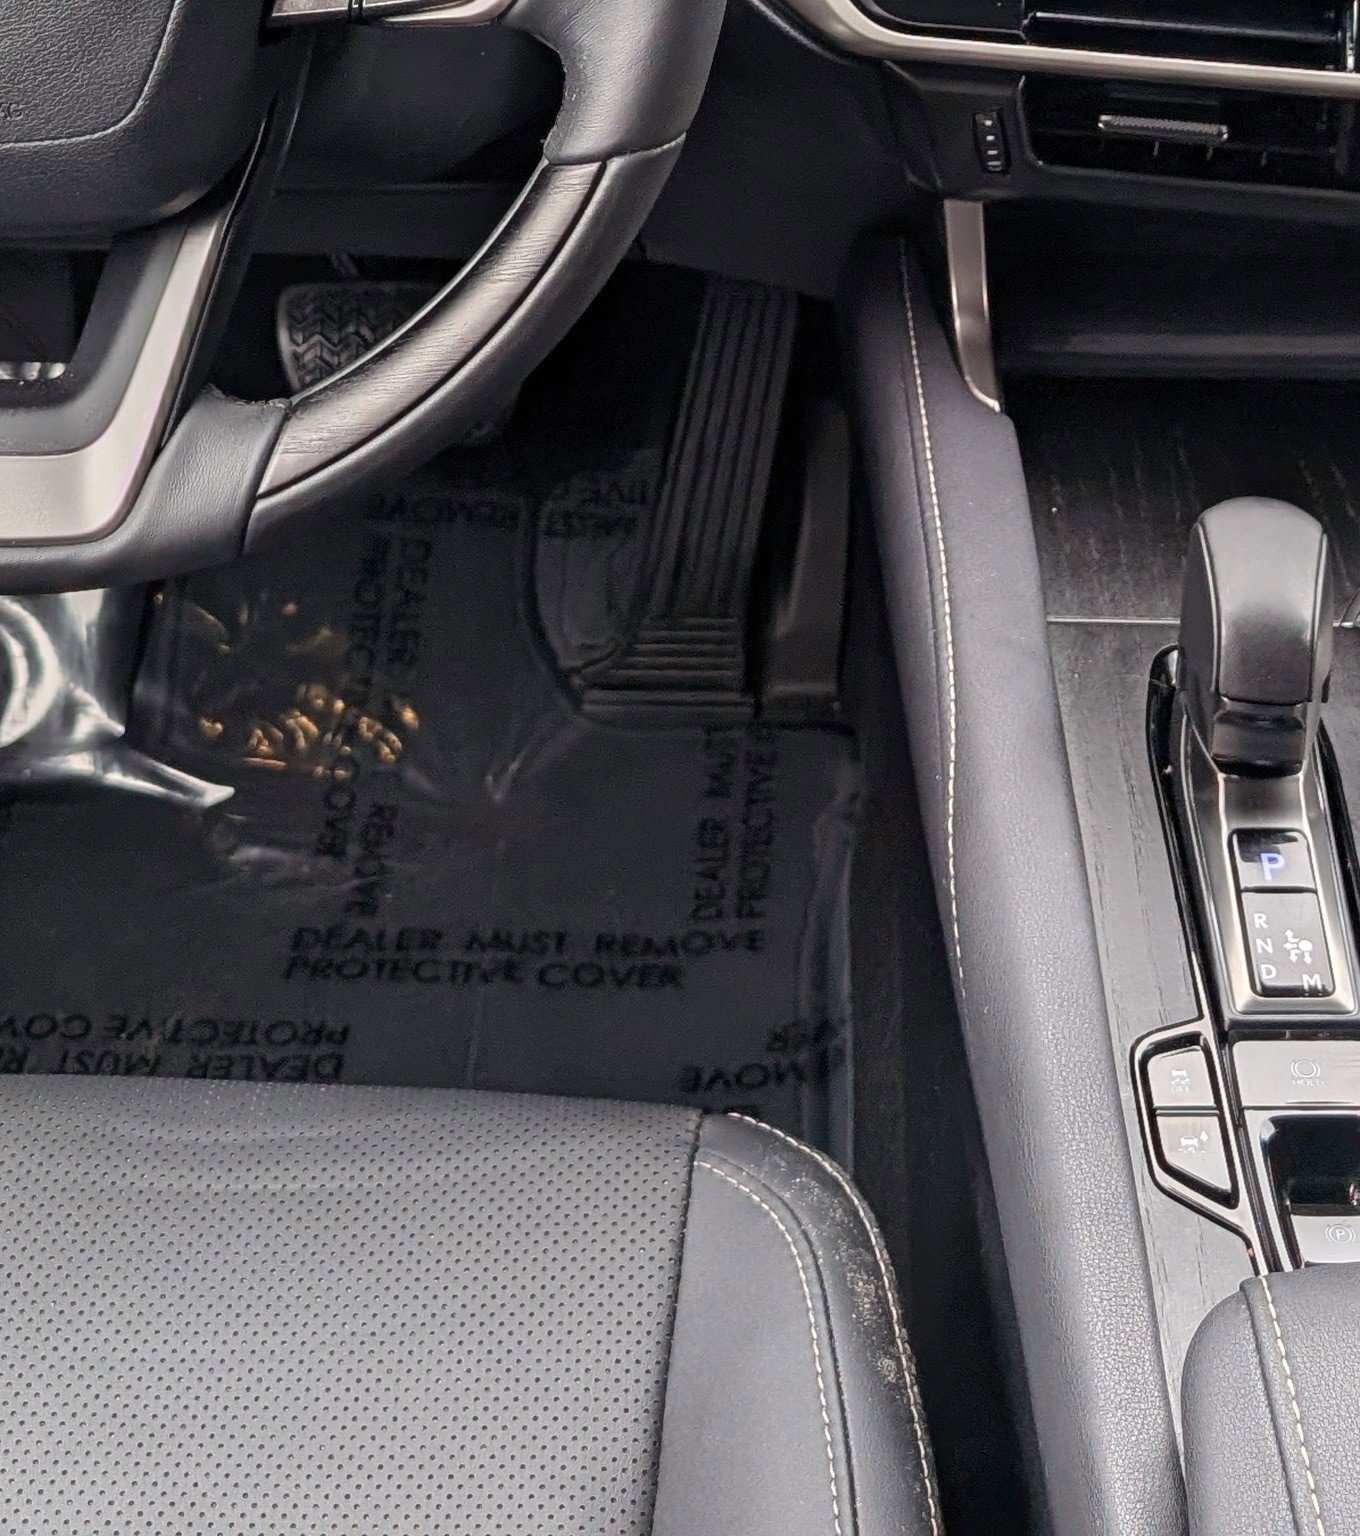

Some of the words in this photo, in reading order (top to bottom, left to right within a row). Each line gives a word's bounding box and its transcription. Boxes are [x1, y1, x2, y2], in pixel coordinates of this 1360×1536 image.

[1261, 852, 1285, 881] P
[1253, 913, 1268, 928] R
[291, 925, 443, 954] DEALER
[466, 929, 568, 956] MUST
[595, 928, 767, 958] REMOVE
[1256, 938, 1273, 953] N
[284, 955, 525, 987] PROTECTIVE
[538, 961, 690, 992] COVER
[1260, 964, 1276, 979] D
[1302, 973, 1322, 992] M
